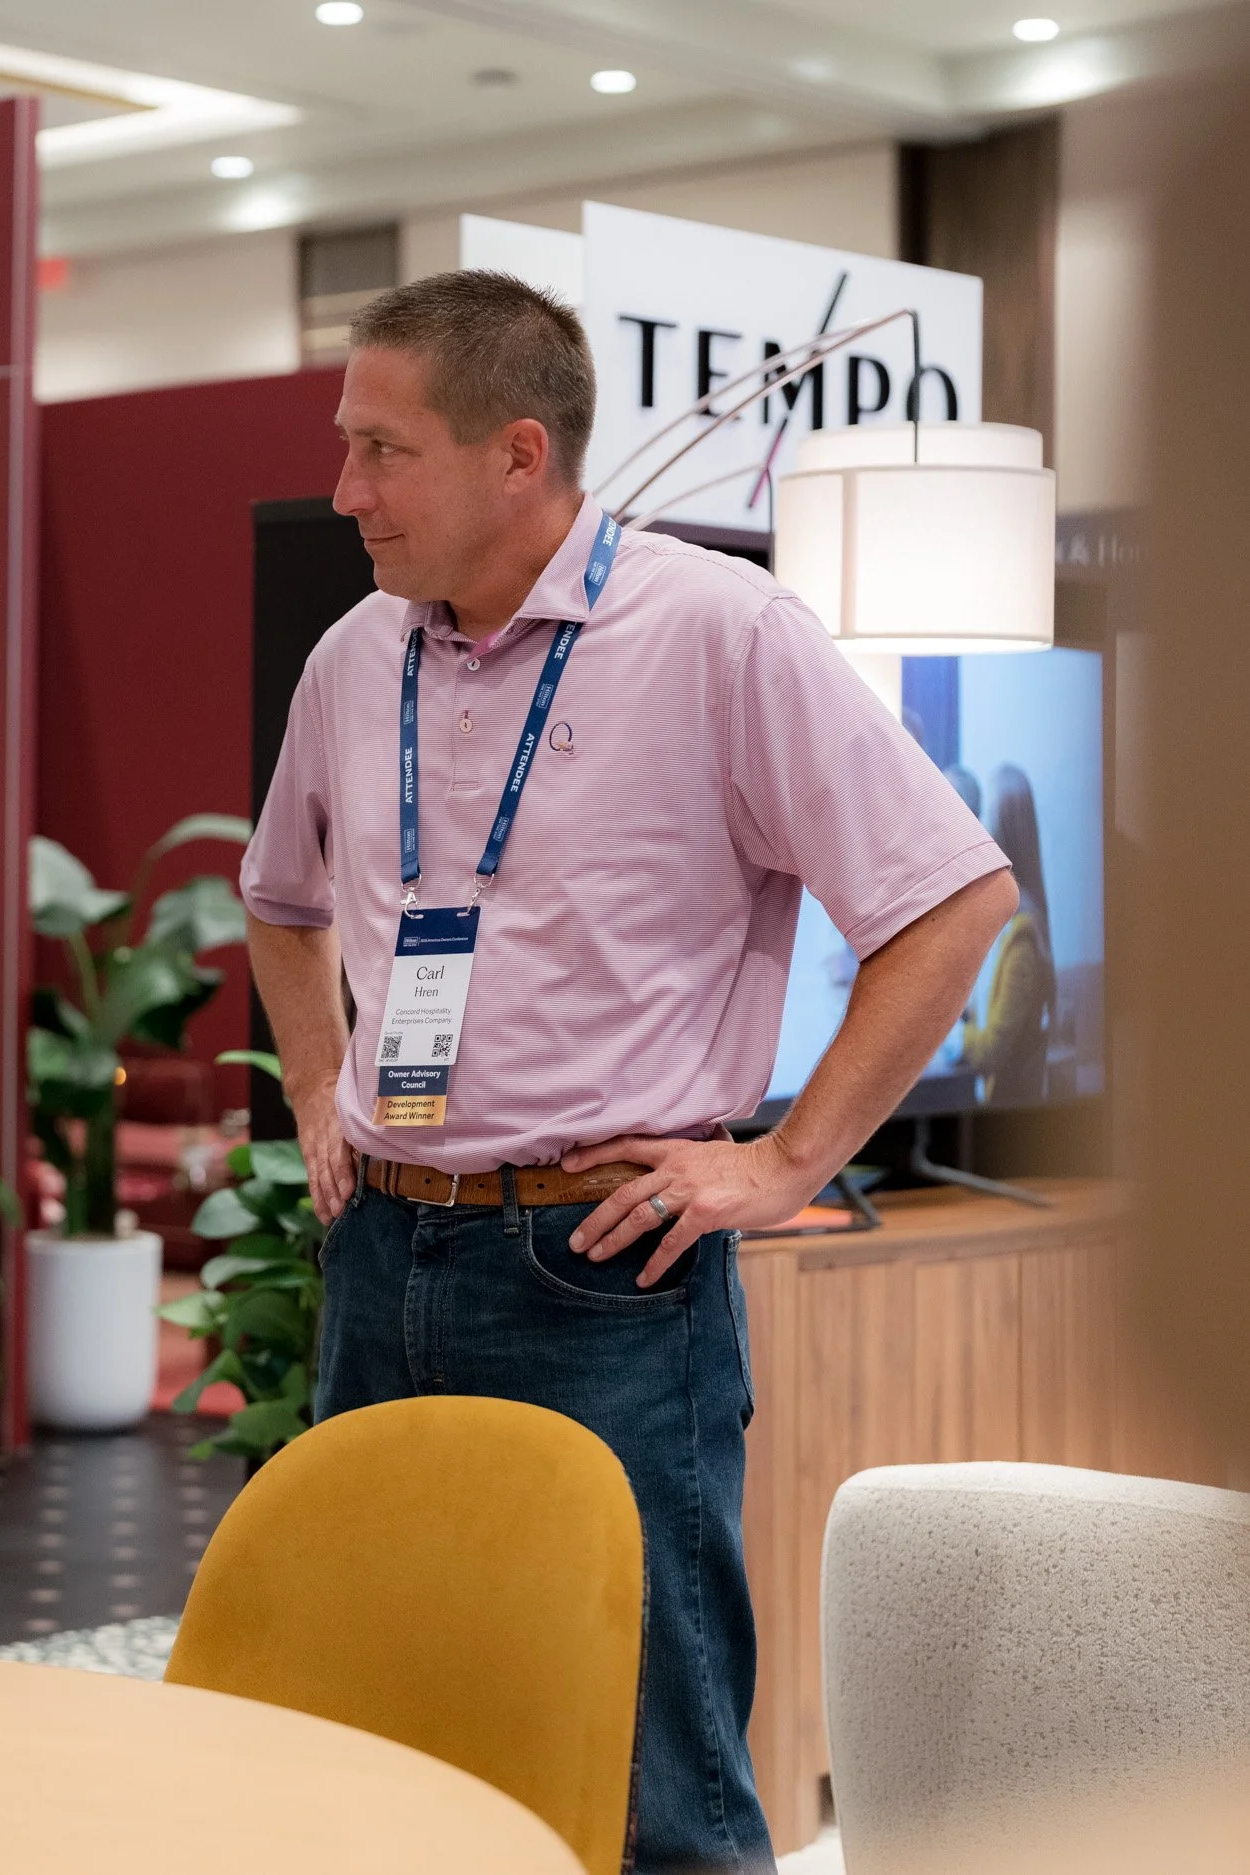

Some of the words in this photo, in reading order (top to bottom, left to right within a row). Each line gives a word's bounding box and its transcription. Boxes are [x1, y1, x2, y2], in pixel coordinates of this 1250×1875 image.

[617, 314, 958, 430] TEMPO
[554, 622, 576, 660] ENDEE
[510, 733, 535, 793] ATTENDEE
[405, 746, 413, 804] ATTENDEE
[416, 965, 445, 981] Carl
[414, 986, 439, 997] Hren
[395, 1008, 420, 1016] Concord
[420, 1008, 452, 1016] Hospitality
[424, 1017, 452, 1025] Company
[388, 1070, 410, 1078] Owner
[410, 1070, 441, 1079] Advisory
[401, 1081, 427, 1089] Council
[387, 1100, 436, 1109] Development
[383, 1112, 408, 1120] Award
[408, 1112, 435, 1120] Winner
